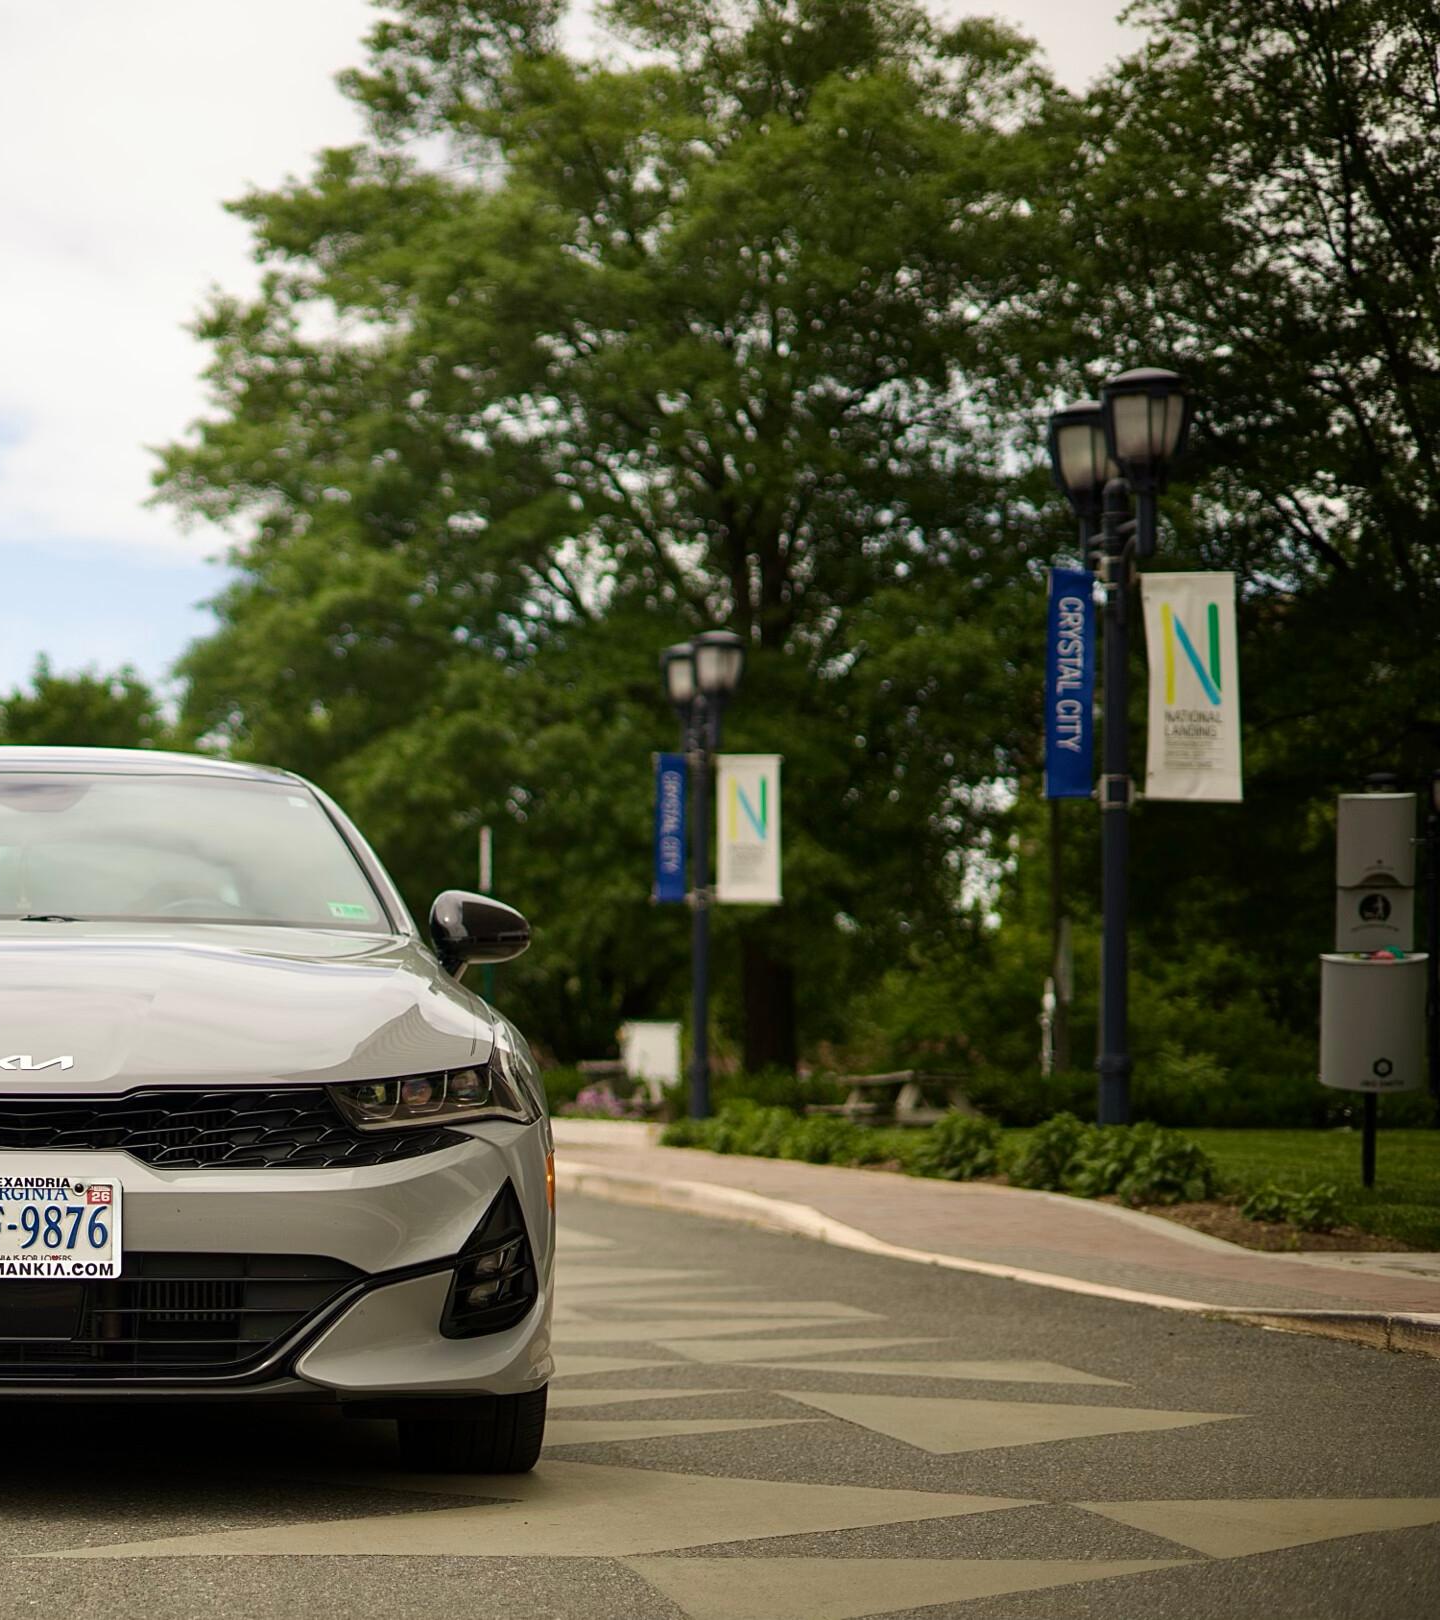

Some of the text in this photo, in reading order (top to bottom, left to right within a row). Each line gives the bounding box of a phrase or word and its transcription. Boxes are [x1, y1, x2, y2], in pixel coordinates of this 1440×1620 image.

[1055, 597, 1085, 752] CRYSTAL CITY
[1164, 710, 1223, 724] NATIONAL
[1164, 725, 1217, 737] LANDING
[91, 1192, 110, 1202] 26
